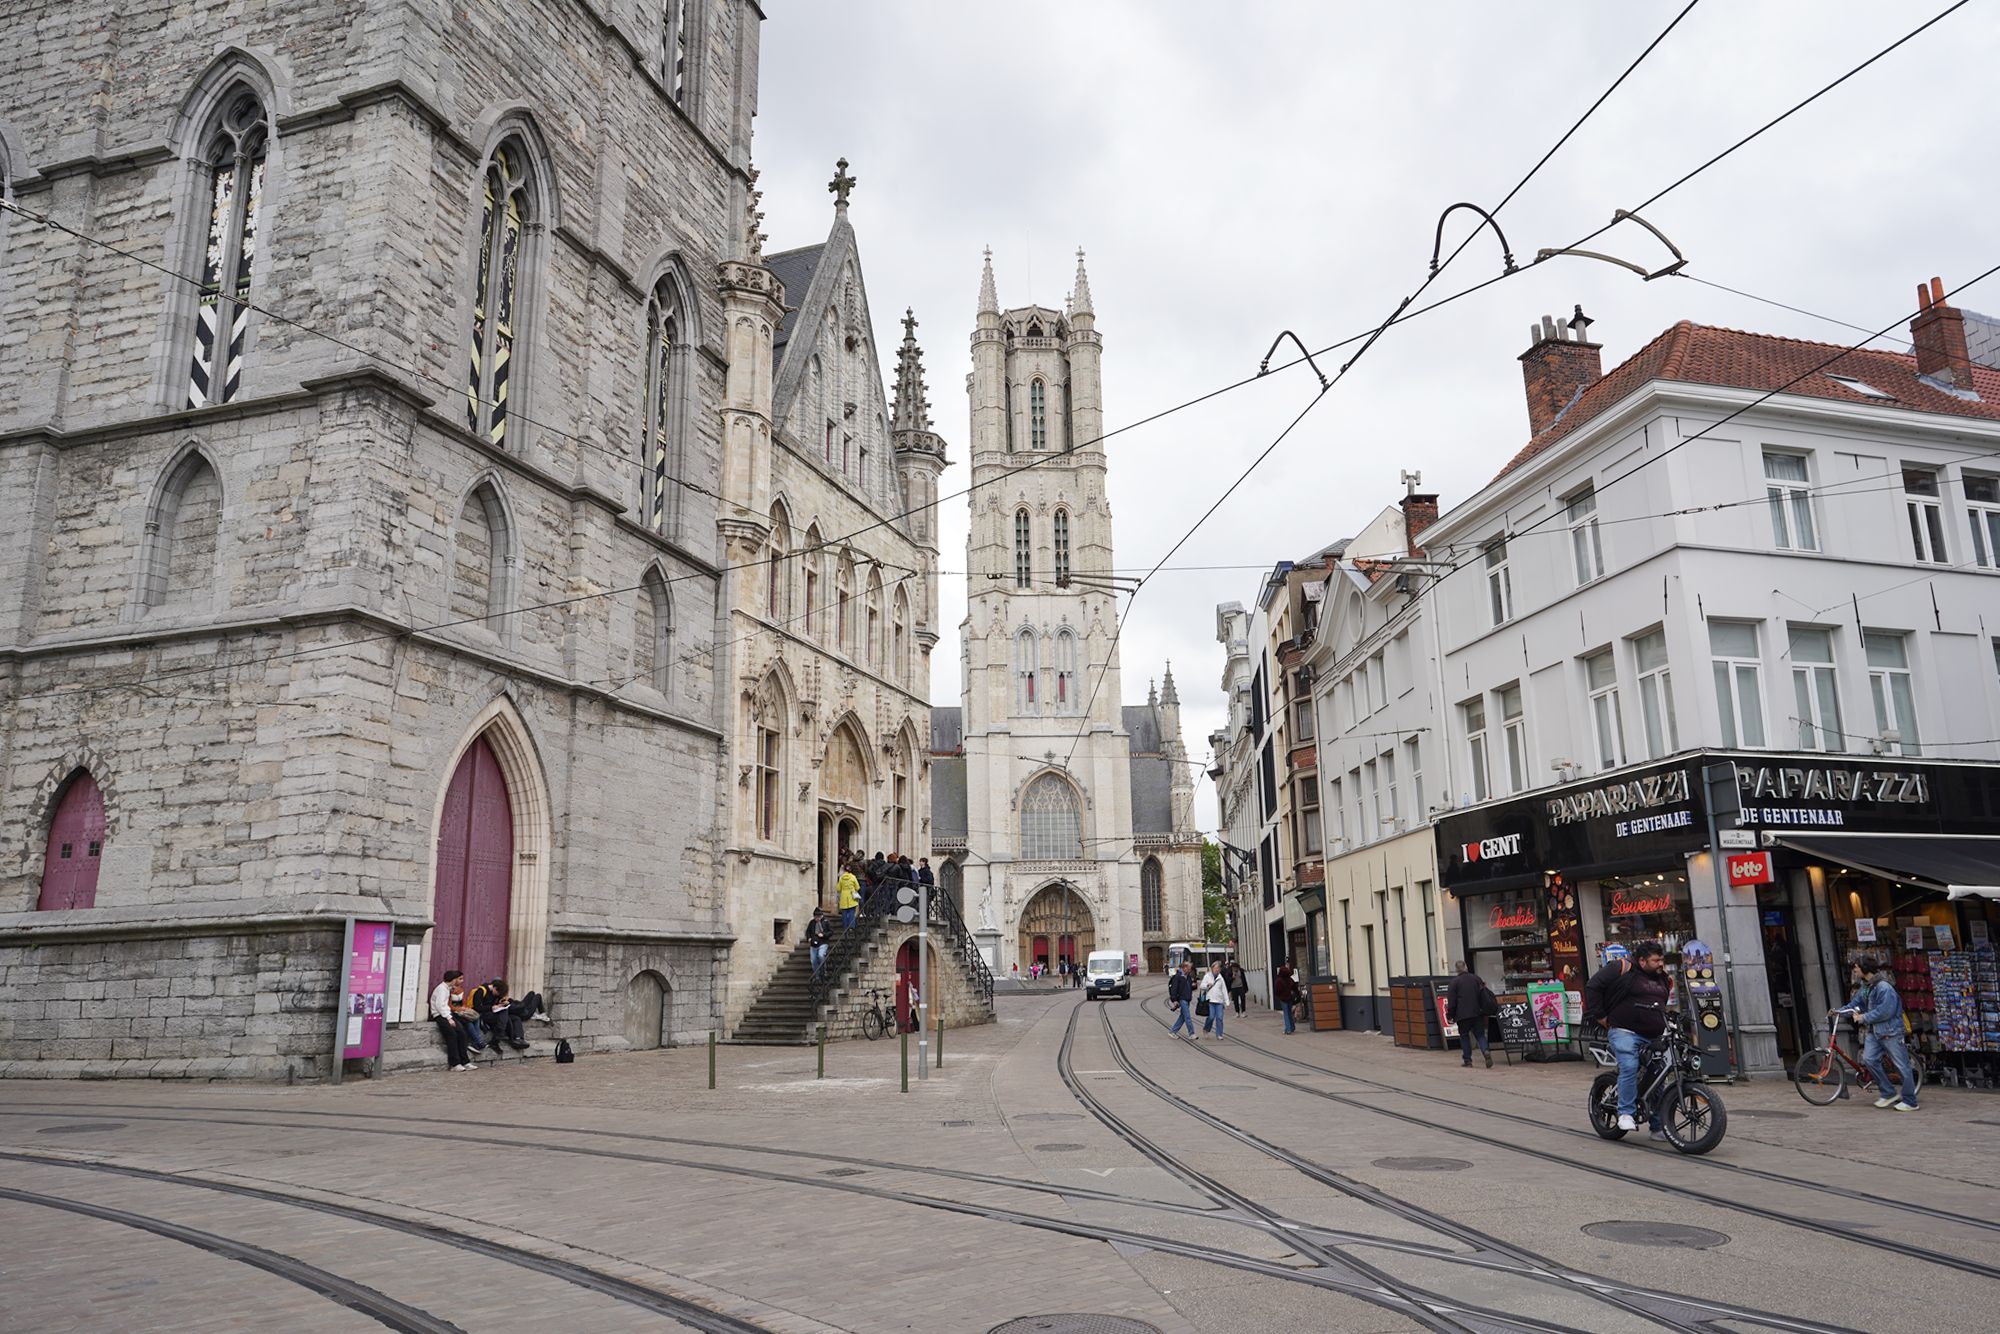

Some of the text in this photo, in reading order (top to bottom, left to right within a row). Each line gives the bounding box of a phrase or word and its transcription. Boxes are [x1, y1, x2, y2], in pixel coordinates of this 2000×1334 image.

[1546, 770, 1689, 826] PAPARAZZI
[1738, 766, 1930, 803] PAPARAZZI
[1615, 811, 1688, 838] DE GENTENAAR
[1742, 807, 1844, 825] DE GENTENAAR
[1461, 833, 1521, 864] I GENT
[1488, 903, 1537, 929] Chocolate
[1610, 891, 1671, 916] Souvenirs
